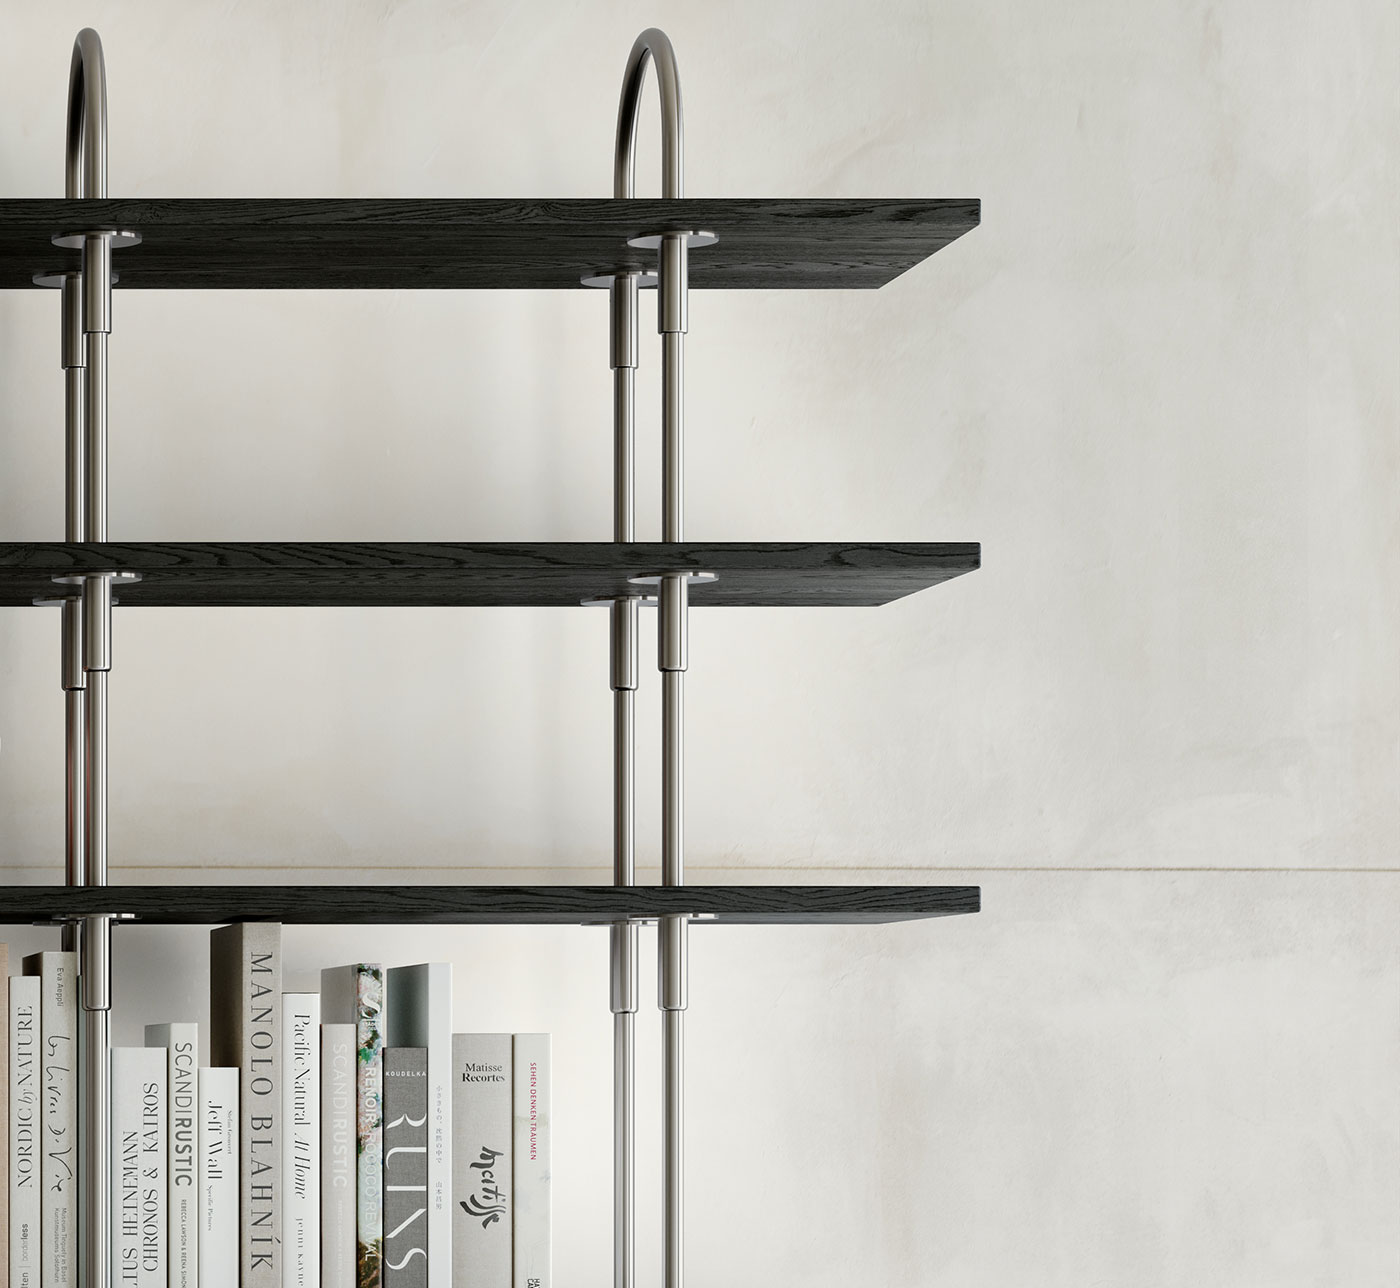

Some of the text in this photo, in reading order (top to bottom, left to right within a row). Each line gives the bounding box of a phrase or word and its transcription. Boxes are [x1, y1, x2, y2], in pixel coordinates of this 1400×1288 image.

[56, 967, 65, 1007] Eva Aeppli
[18, 1005, 34, 1086] NATURE
[462, 1073, 505, 1082] Recortes
[465, 1063, 503, 1072] Matisse
[529, 1062, 537, 1088] SEHEN
[175, 1042, 193, 1187] SCANDIRUSTIC
[250, 952, 282, 1271] MANOLO BLAHNÍK
[293, 1013, 311, 1200] Pacific Natural At Home
[332, 1042, 348, 1188] SCANDIRUSTIC
[529, 1088, 537, 1121] DENKEN
[18, 1108, 34, 1188] NORDIC
[207, 1100, 223, 1179] Jeff Wall
[364, 1133, 377, 1197] ROCOCO
[122, 1130, 138, 1236] HEINEMANN
[143, 1082, 160, 1272] CHRONOS & KAIROS
[385, 1113, 427, 1271] RUINS
[180, 1198, 188, 1222] REBECCA
[180, 1223, 188, 1246] LAWSON
[364, 1201, 377, 1262] REVIVAL
[180, 1252, 188, 1270] REENA
[180, 1270, 188, 1288] SIMON
